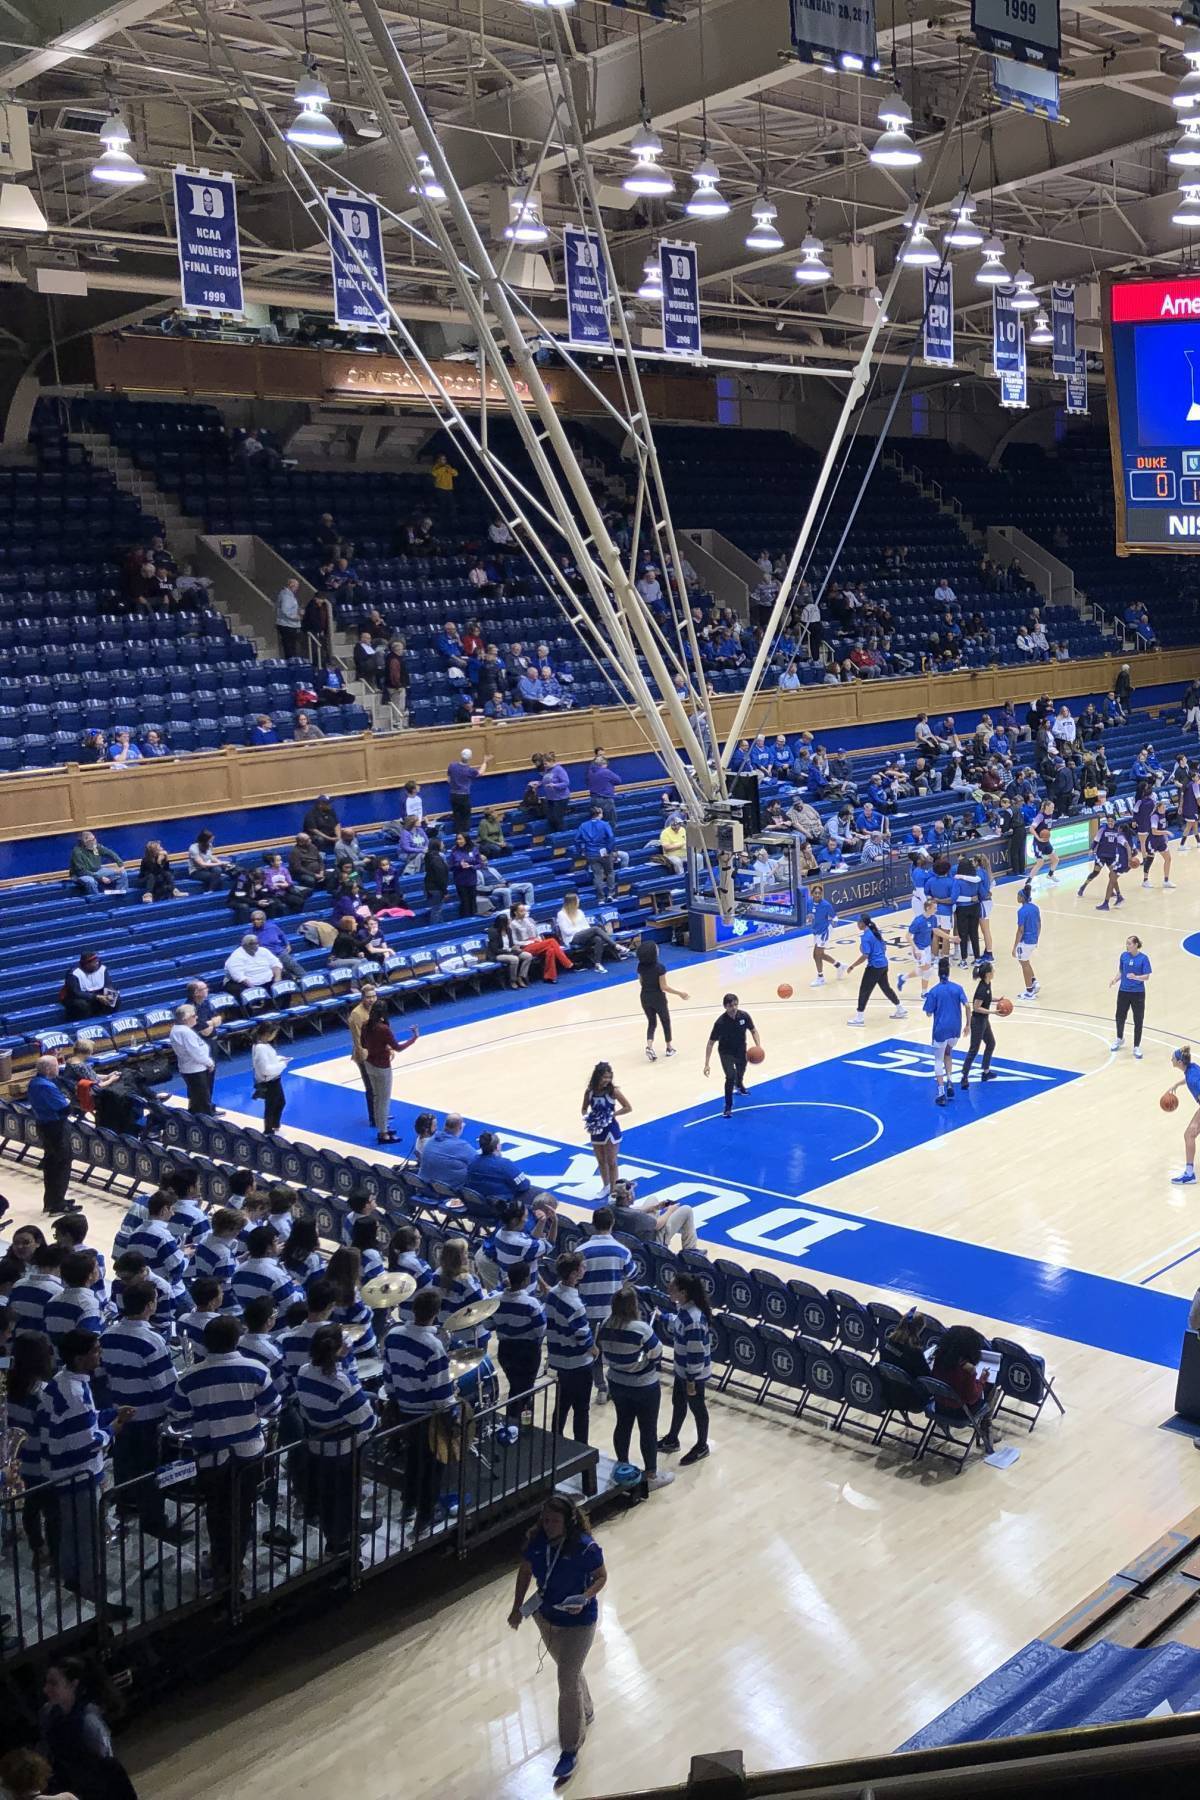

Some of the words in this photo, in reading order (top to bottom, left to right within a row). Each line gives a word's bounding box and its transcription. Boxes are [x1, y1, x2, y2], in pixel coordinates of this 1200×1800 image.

[1004, 0, 1037, 25] 1999
[196, 227, 222, 241] NCAA
[188, 243, 232, 260] WOMEN'S
[184, 260, 211, 276] FINAL
[213, 264, 238, 278] FOUR
[578, 275, 597, 286] NCAA
[202, 290, 226, 303] 1999
[673, 287, 689, 297] NCAA
[571, 303, 589, 314] FINAL
[668, 300, 695, 311] WOMEN'S
[665, 313, 682, 323] FINAL
[683, 315, 698, 325] FOUR
[999, 320, 1016, 343] 10
[1061, 324, 1068, 345] 1
[1136, 456, 1168, 470] DUKE
[1155, 473, 1168, 497] 0
[436, 945, 457, 957] DUKE
[461, 940, 482, 951] DUKE
[386, 955, 407, 968] DUKE
[411, 951, 432, 963] DUKE
[331, 969, 353, 981] DUKE
[359, 963, 381, 975] DUKE
[302, 974, 325, 987] DUKE
[242, 987, 267, 1001] DUKE
[273, 981, 297, 995] DUKE
[211, 994, 237, 1008] DUKE
[115, 1017, 139, 1031] DUKE
[148, 1010, 174, 1024] DUKE
[78, 1026, 104, 1040] DUKE
[42, 1035, 70, 1049] DUKE
